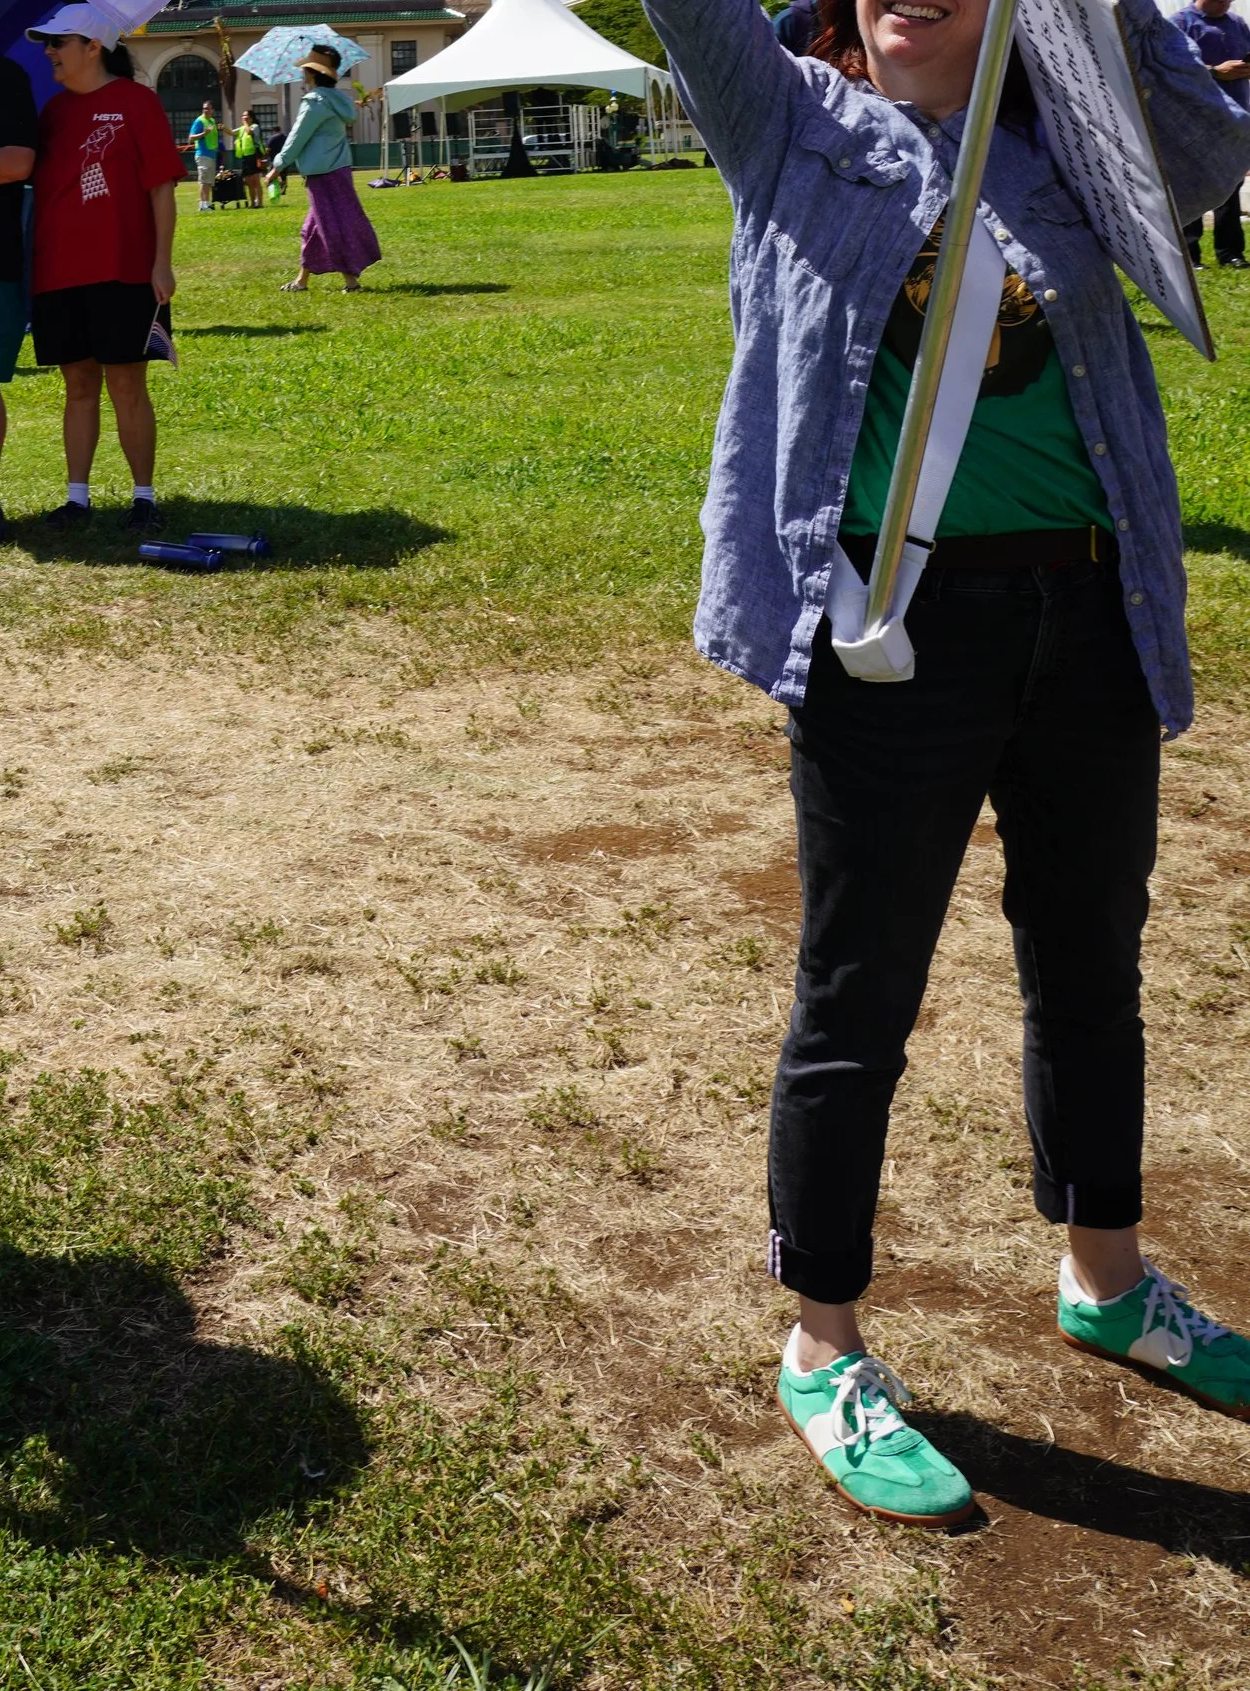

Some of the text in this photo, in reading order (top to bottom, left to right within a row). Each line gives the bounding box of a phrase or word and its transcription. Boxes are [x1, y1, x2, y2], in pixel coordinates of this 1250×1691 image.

[1063, 42, 1082, 84] the
[92, 113, 124, 121] HSTA
[1078, 90, 1091, 115] in
[1052, 109, 1079, 180] trump
[1068, 116, 1092, 176] what
[1088, 181, 1112, 247] know
[1104, 187, 1123, 222] hit
[1139, 221, 1154, 254] the
[1150, 257, 1166, 300] stop
